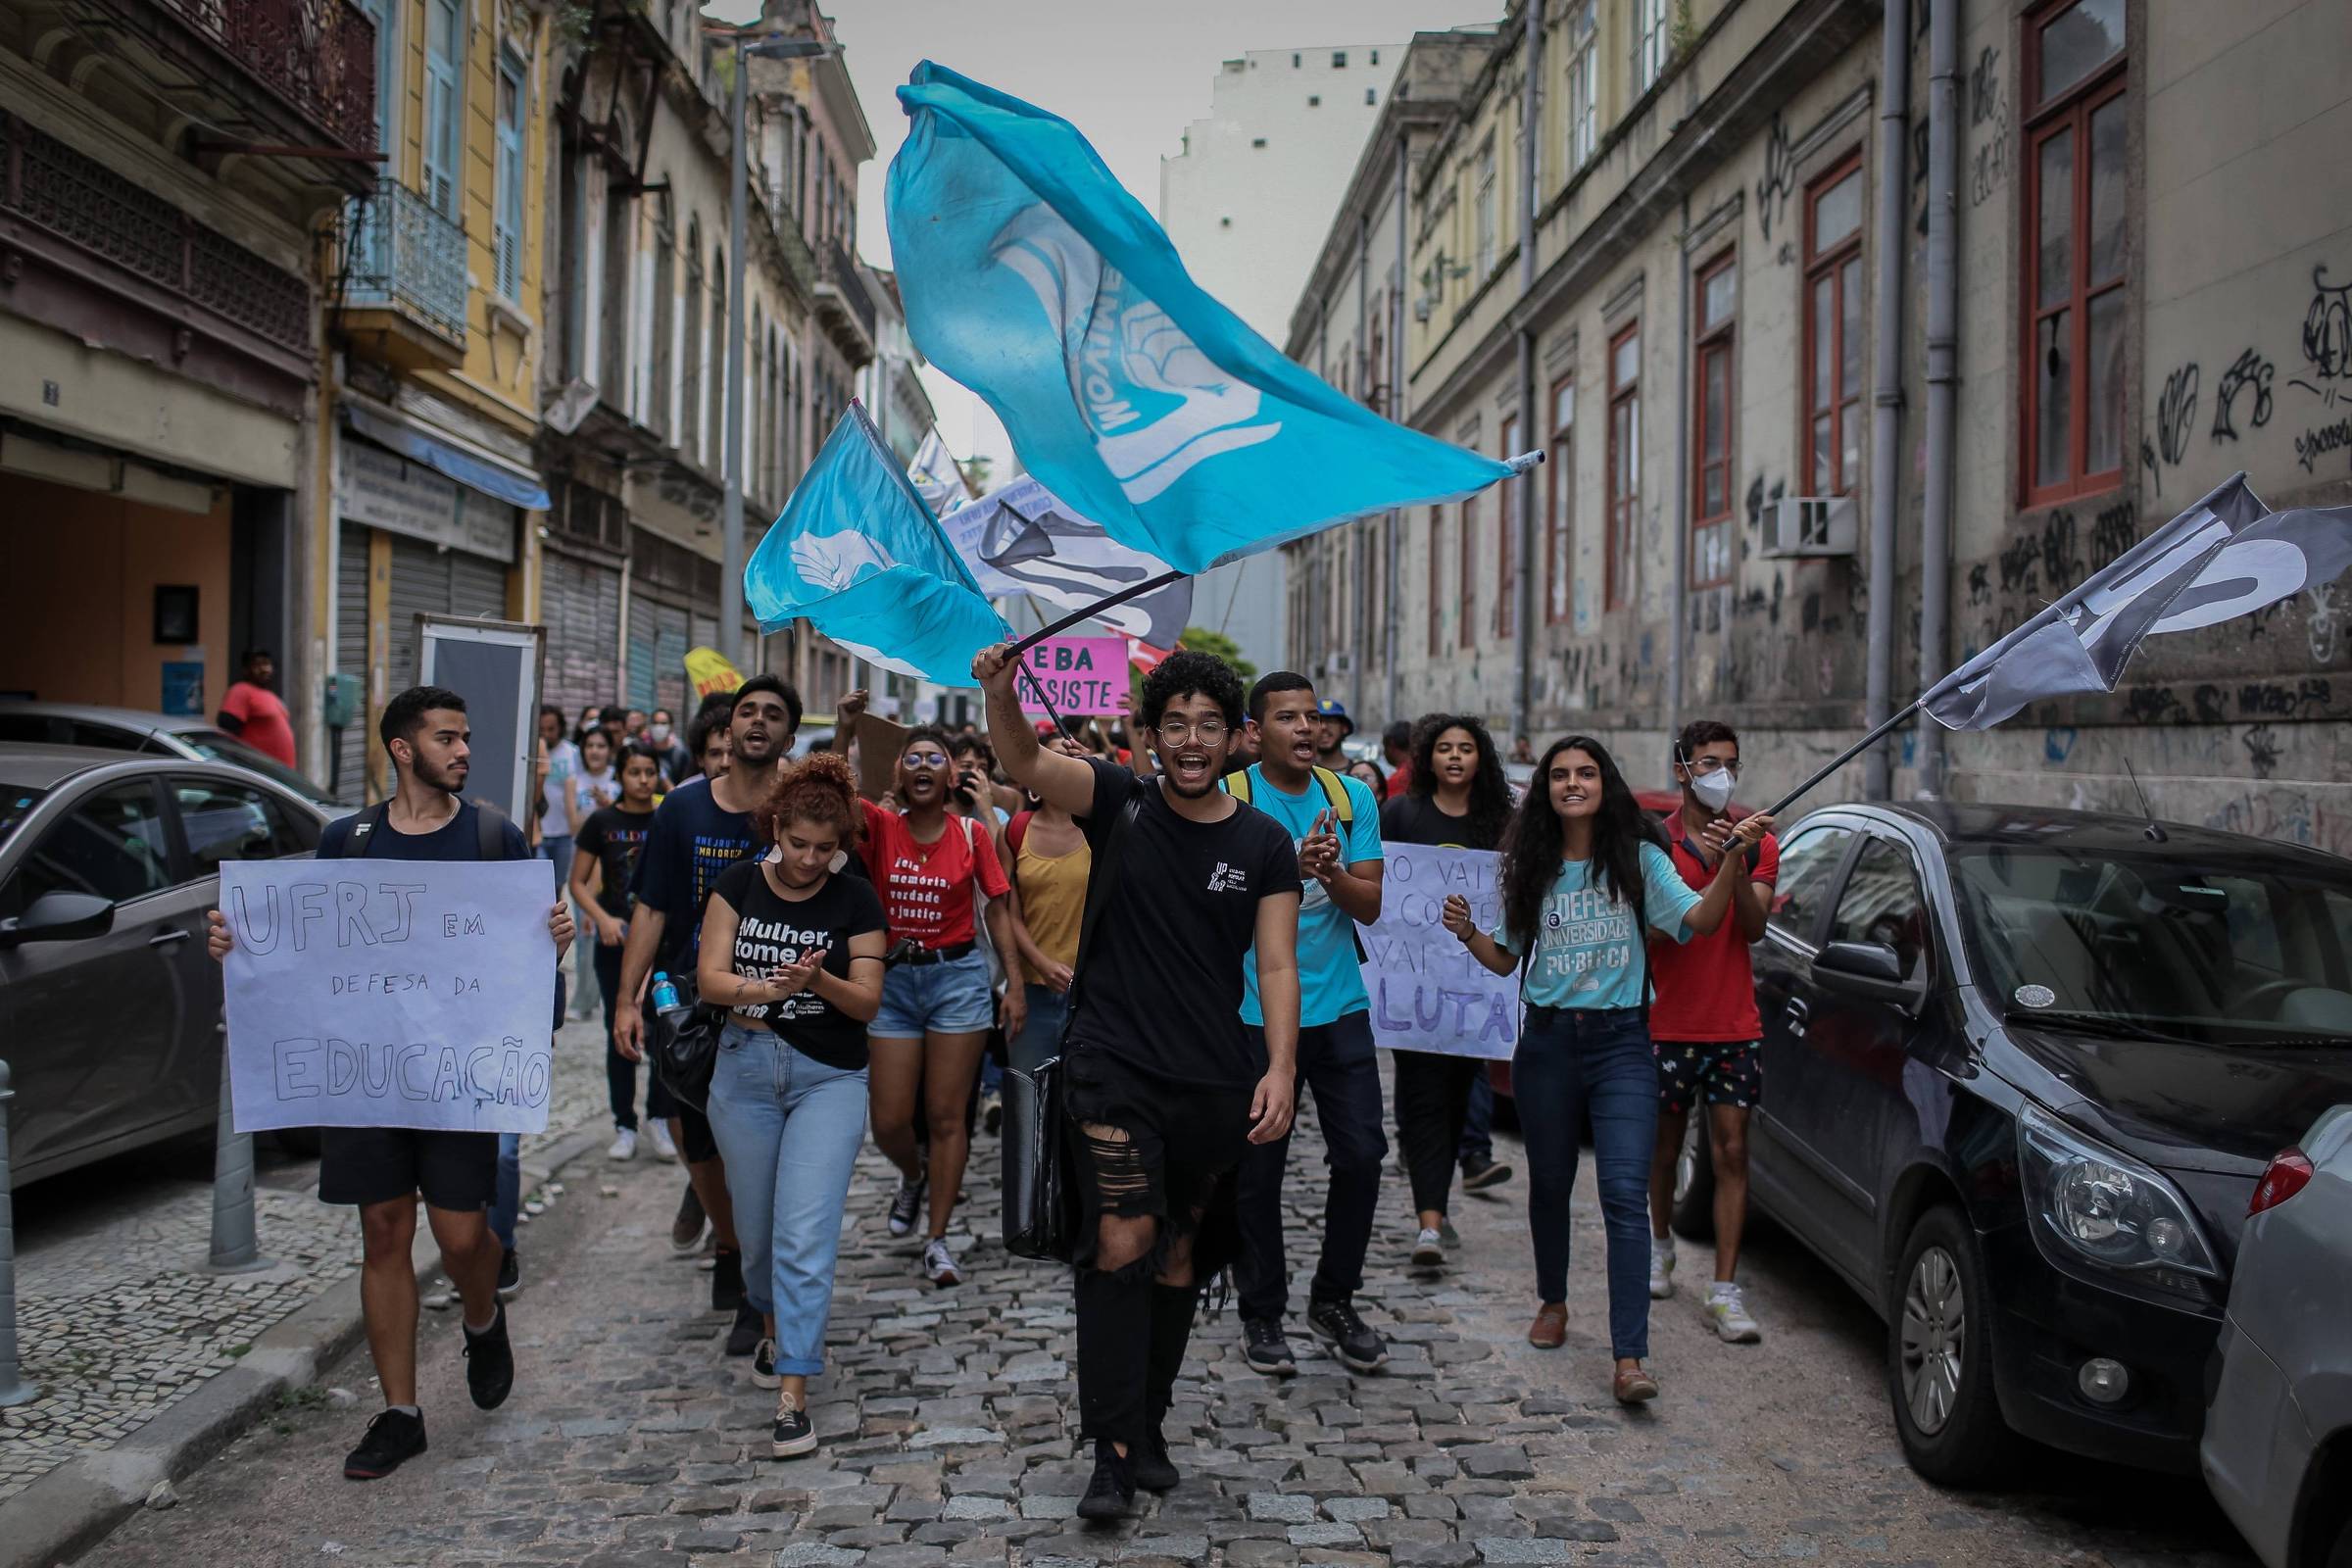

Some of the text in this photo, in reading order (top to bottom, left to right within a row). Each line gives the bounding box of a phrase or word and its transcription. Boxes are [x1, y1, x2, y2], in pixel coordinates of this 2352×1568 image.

[1034, 646, 1094, 671] EBA
[1017, 678, 1112, 709] RESISTE
[889, 874, 951, 890] memória,
[1437, 859, 1481, 889] VAI
[890, 890, 941, 904] verdade
[232, 881, 485, 956] UFRJ EM
[889, 906, 942, 922] e justiça
[739, 917, 833, 950] Mulher,
[1541, 918, 1631, 949] UNIVERSIDADE
[735, 937, 797, 964] tome
[1369, 940, 1425, 976] VAI
[331, 973, 480, 995] DEFESA DA
[1377, 977, 1514, 1042] LUTA
[273, 1036, 553, 1109] EDUCAÇÃO
